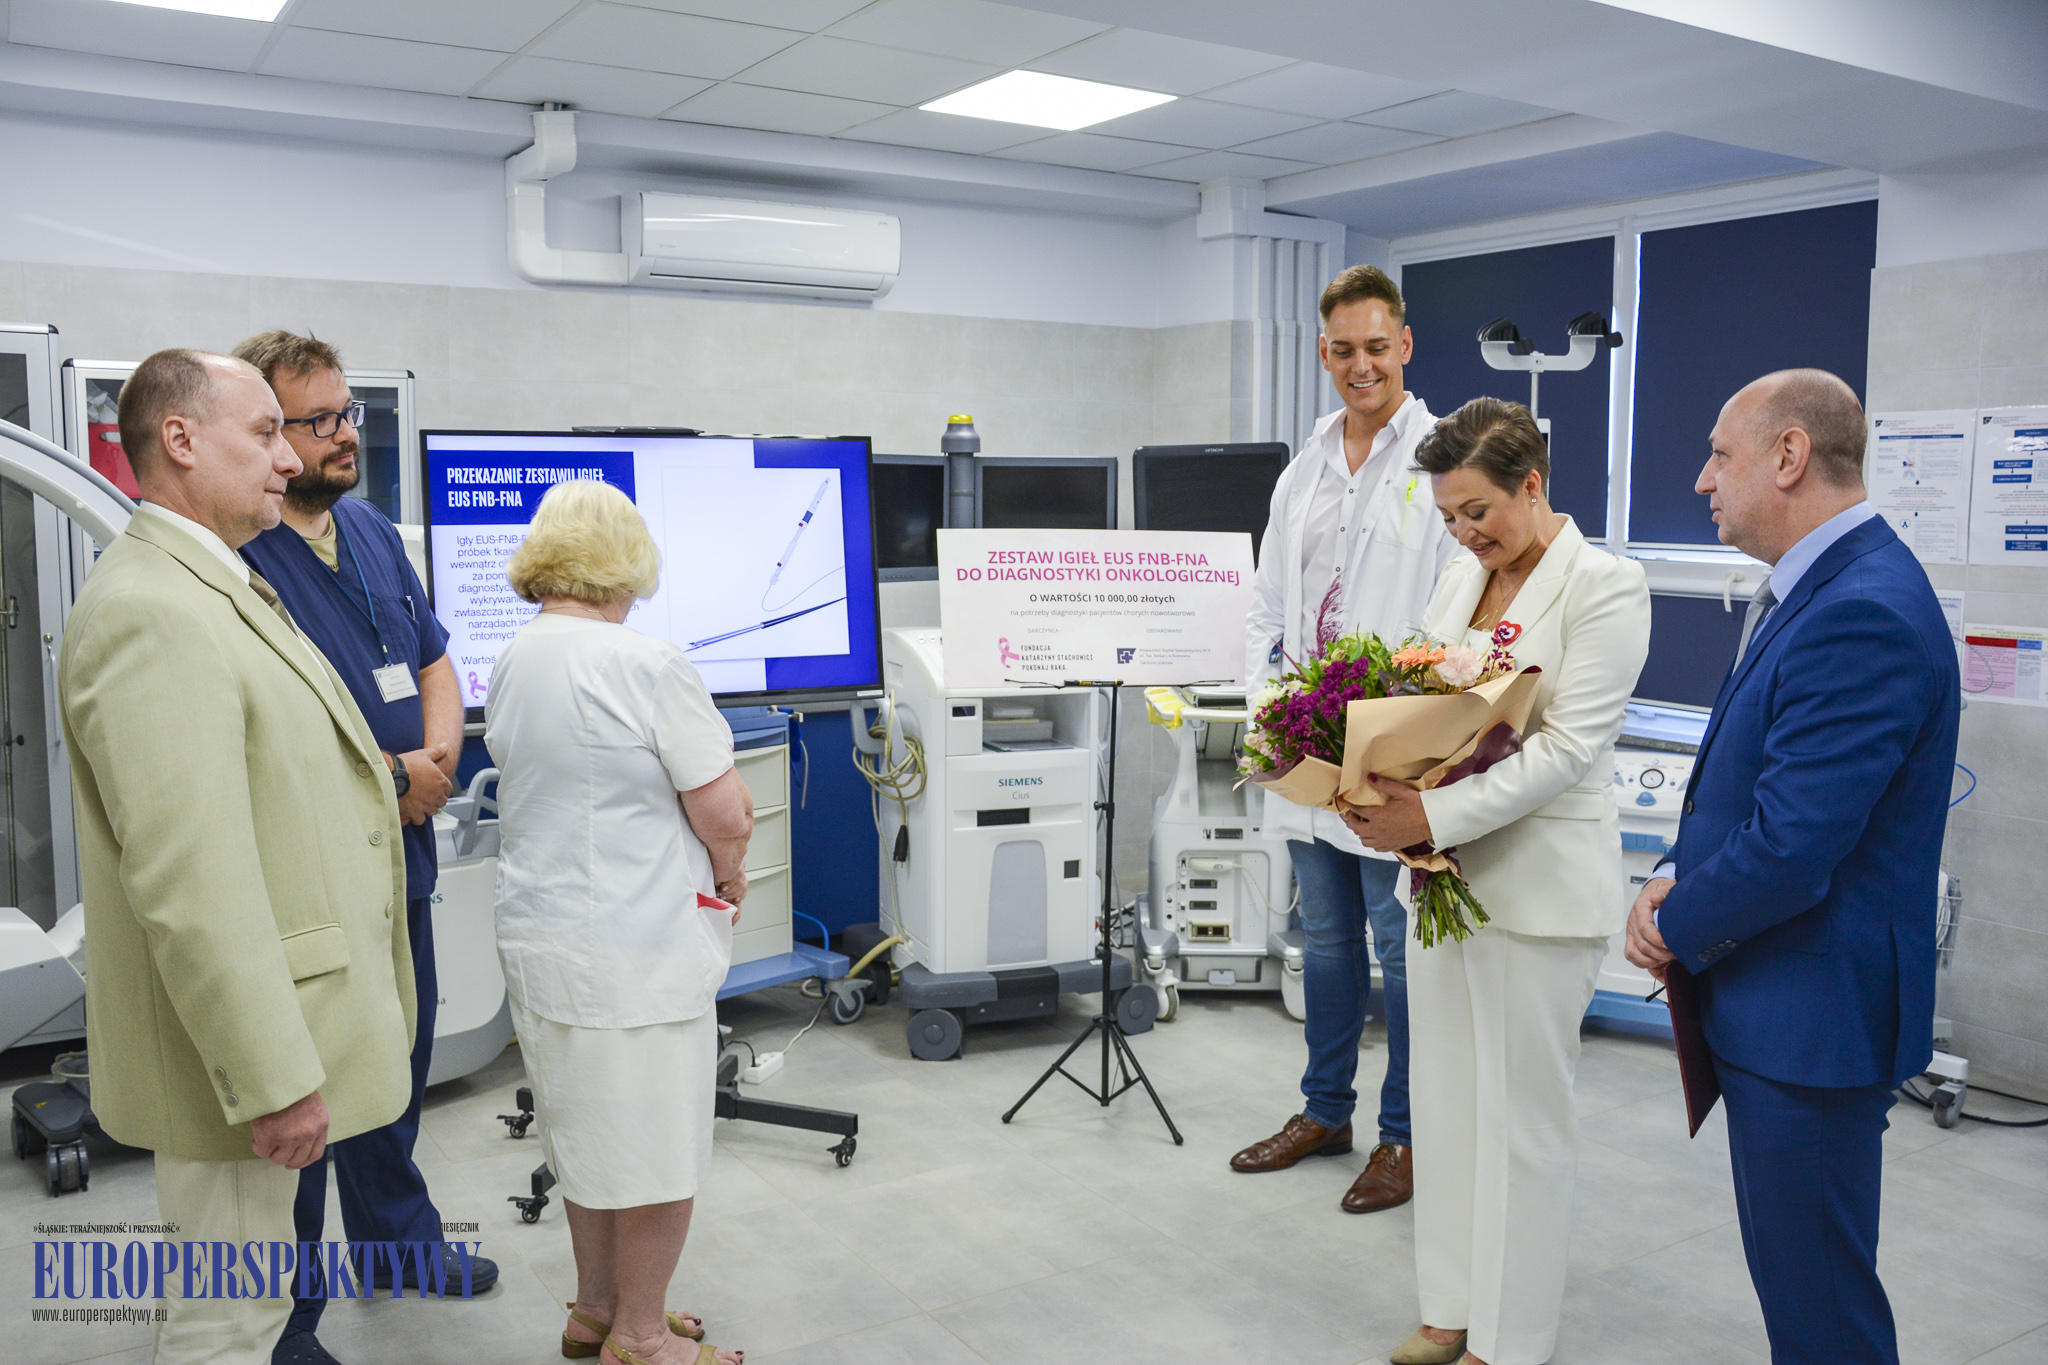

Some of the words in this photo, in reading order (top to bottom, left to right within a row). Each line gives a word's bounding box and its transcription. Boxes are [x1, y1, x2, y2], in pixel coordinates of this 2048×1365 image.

[447, 467, 524, 484] PRZEKAZANIE
[525, 467, 576, 484] ZESTAWU
[577, 468, 606, 484] IGIEŁ
[448, 491, 471, 507] EUS
[472, 490, 523, 507] FNB-FNA
[476, 534, 527, 545] EUS-FNB-F
[457, 547, 492, 559] próbek
[987, 551, 1054, 564] ZESTAW
[1059, 551, 1099, 565] IGIEŁ
[1103, 552, 1134, 565] EUS
[1138, 553, 1209, 566] FNB-FNA
[450, 560, 497, 570] wewnątrz
[472, 573, 484, 581] za
[485, 572, 506, 582] pom
[957, 568, 982, 581] DO
[987, 568, 1100, 581] DIAGNOSTYKI
[1105, 568, 1240, 586] ONKOLOGICZNEJ
[1029, 594, 1038, 602] O
[1040, 592, 1091, 602] WARTOŚCI
[1094, 594, 1105, 602] 10
[1107, 594, 1138, 603] 000,00
[1140, 594, 1175, 605] złotych
[454, 607, 503, 617] zwłaszcza
[505, 607, 513, 615] w
[1020, 609, 1050, 617] potrzeby
[1051, 609, 1088, 617] diagnostyki
[1089, 609, 1122, 617] pacjentów
[468, 619, 517, 630] narządach
[461, 655, 496, 665] Wartoś
[998, 776, 1043, 787] SIEMENS
[1012, 790, 1030, 800] Cius
